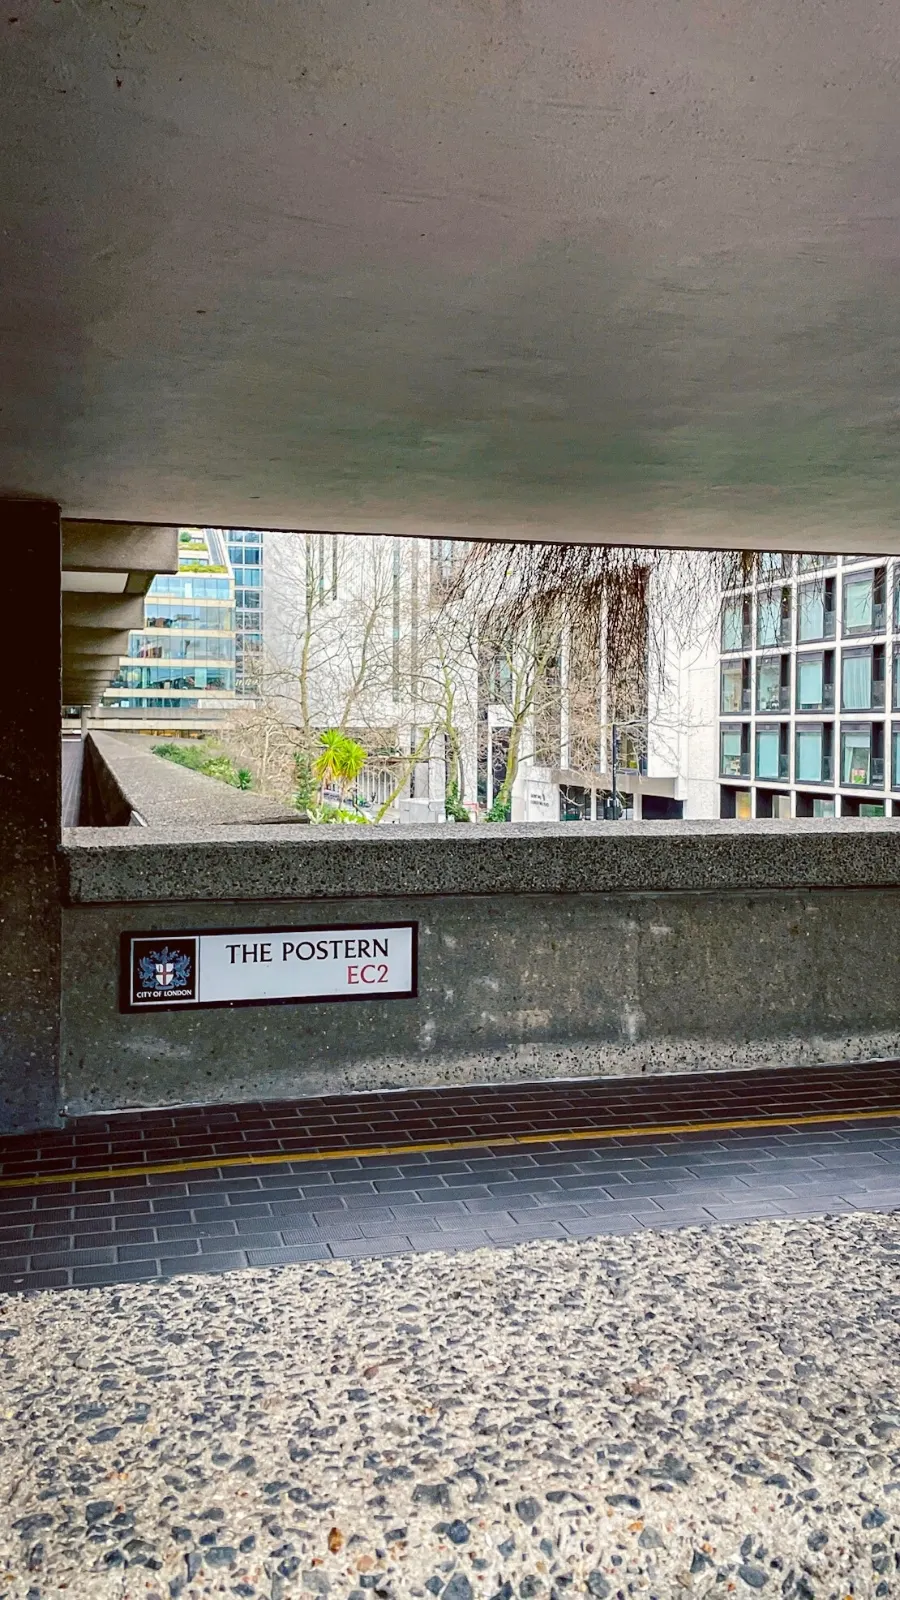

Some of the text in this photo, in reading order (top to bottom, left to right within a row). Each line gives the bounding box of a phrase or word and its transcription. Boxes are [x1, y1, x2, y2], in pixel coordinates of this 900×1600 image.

[226, 938, 389, 963] THE POSTERN
[347, 965, 389, 984] EC2
